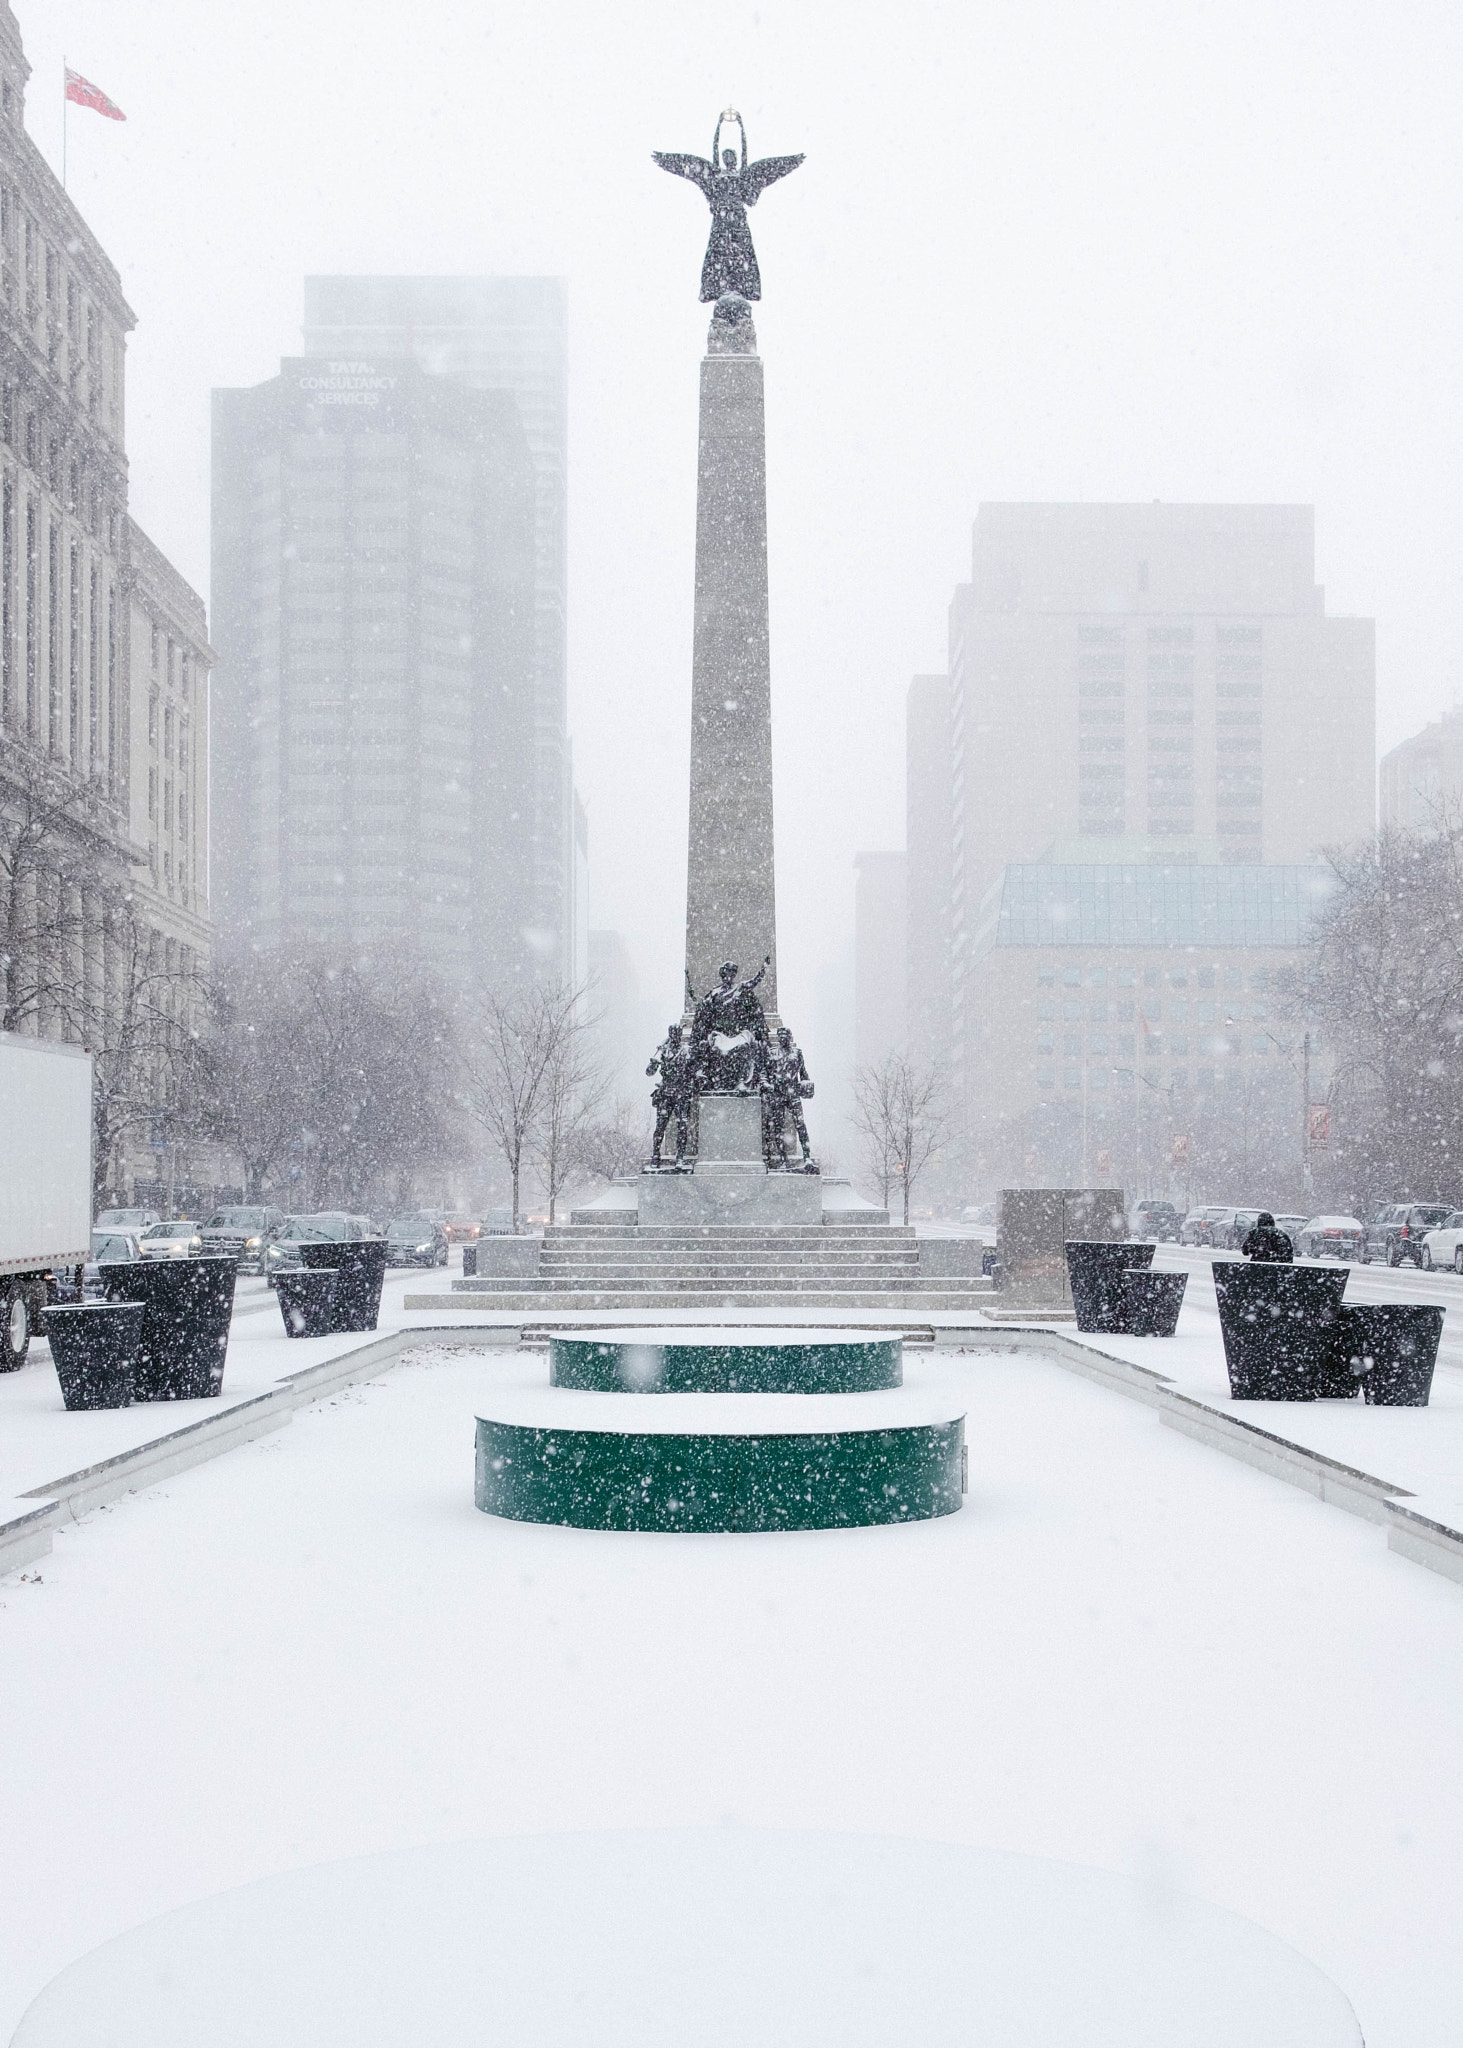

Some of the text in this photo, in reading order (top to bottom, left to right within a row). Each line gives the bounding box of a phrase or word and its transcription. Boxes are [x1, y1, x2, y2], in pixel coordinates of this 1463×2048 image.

[328, 362, 370, 374] TATA
[300, 377, 397, 389] CONSULTANCY
[318, 392, 379, 405] SERVICES
